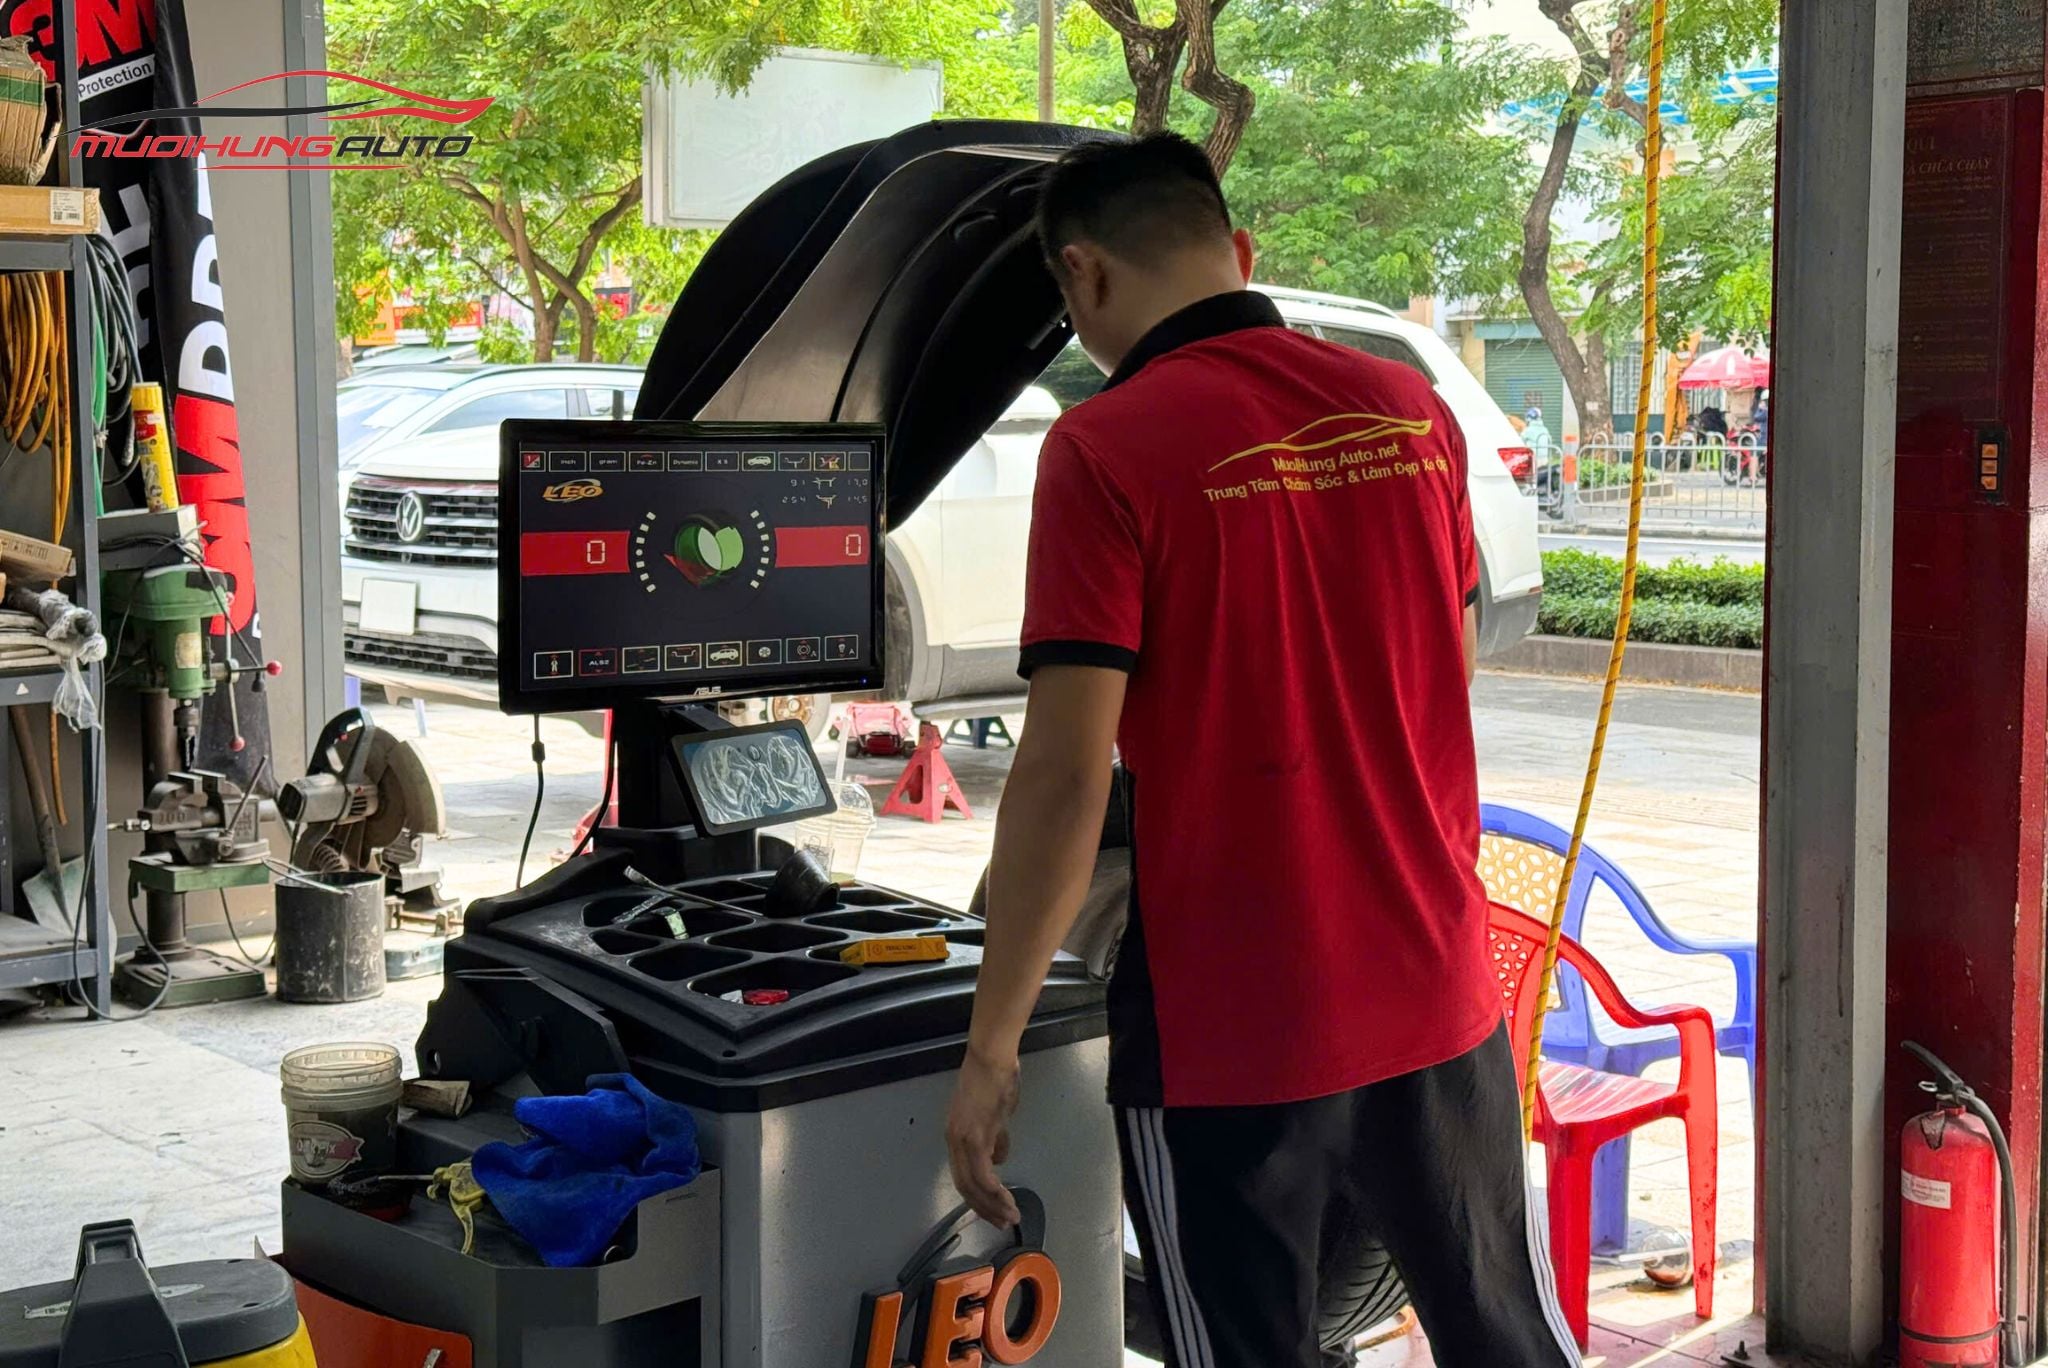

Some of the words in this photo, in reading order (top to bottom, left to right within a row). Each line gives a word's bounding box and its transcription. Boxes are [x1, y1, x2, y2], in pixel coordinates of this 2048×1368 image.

[78, 63, 152, 98] Protection
[542, 484, 604, 499] LEO
[1202, 485, 1248, 502] Trung
[1248, 478, 1280, 493] Tâm
[1313, 474, 1344, 490] Sóc
[1347, 469, 1360, 483] &
[1361, 465, 1392, 481] Làm
[1393, 462, 1420, 477] Đẹp
[586, 539, 606, 565] 0
[845, 534, 862, 557] 0
[693, 685, 722, 696] ASUS
[854, 1250, 1062, 1368] LEO
